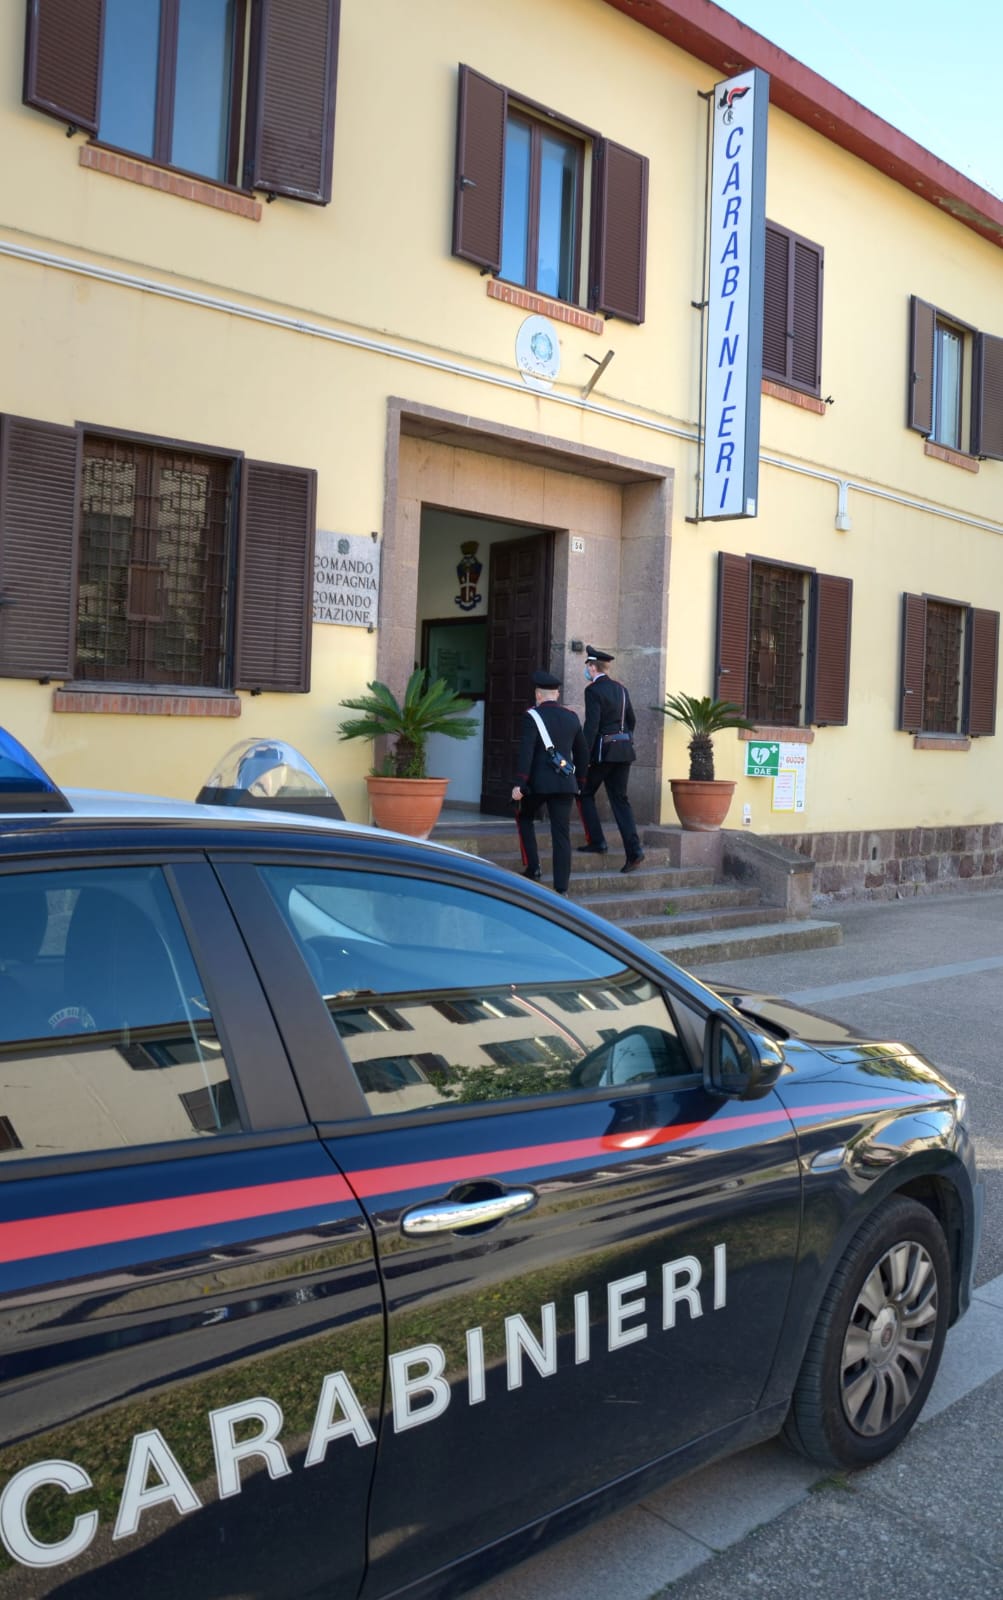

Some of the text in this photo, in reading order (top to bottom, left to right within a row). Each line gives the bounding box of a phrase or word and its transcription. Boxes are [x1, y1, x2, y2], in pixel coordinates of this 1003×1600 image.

[715, 126, 744, 509] CARABINIERI
[313, 555, 374, 575] COMANDO
[313, 571, 377, 590] OMPAGNIA
[313, 591, 372, 609] COMANDO
[0, 1243, 727, 1567] CARABINIERI
